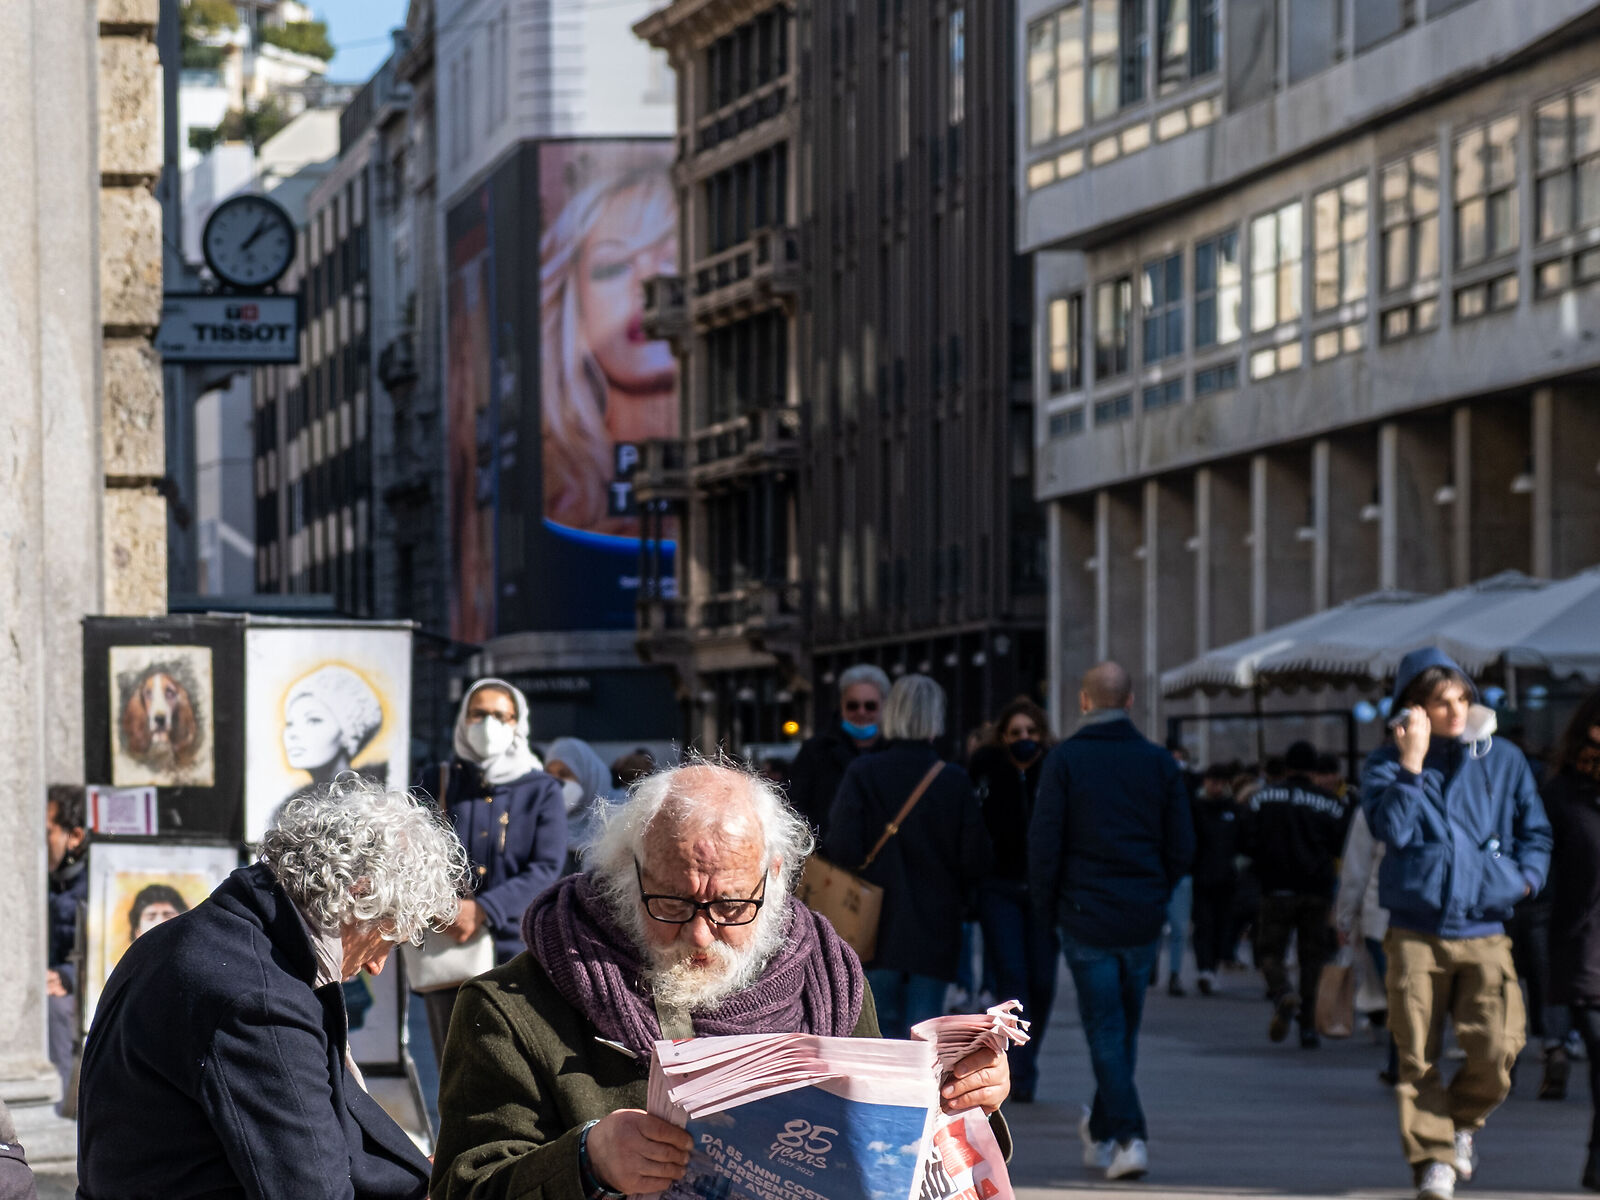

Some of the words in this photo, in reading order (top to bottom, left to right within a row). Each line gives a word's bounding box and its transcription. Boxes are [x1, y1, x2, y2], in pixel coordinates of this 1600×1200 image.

[192, 322, 292, 343] TISSOT
[776, 1118, 839, 1155] 85
[701, 1133, 723, 1150] DA
[725, 1144, 743, 1162] 85
[743, 1160, 781, 1183] ANNI
[705, 1144, 726, 1164] UN
[769, 1141, 828, 1170] years
[713, 1163, 743, 1185] PER
